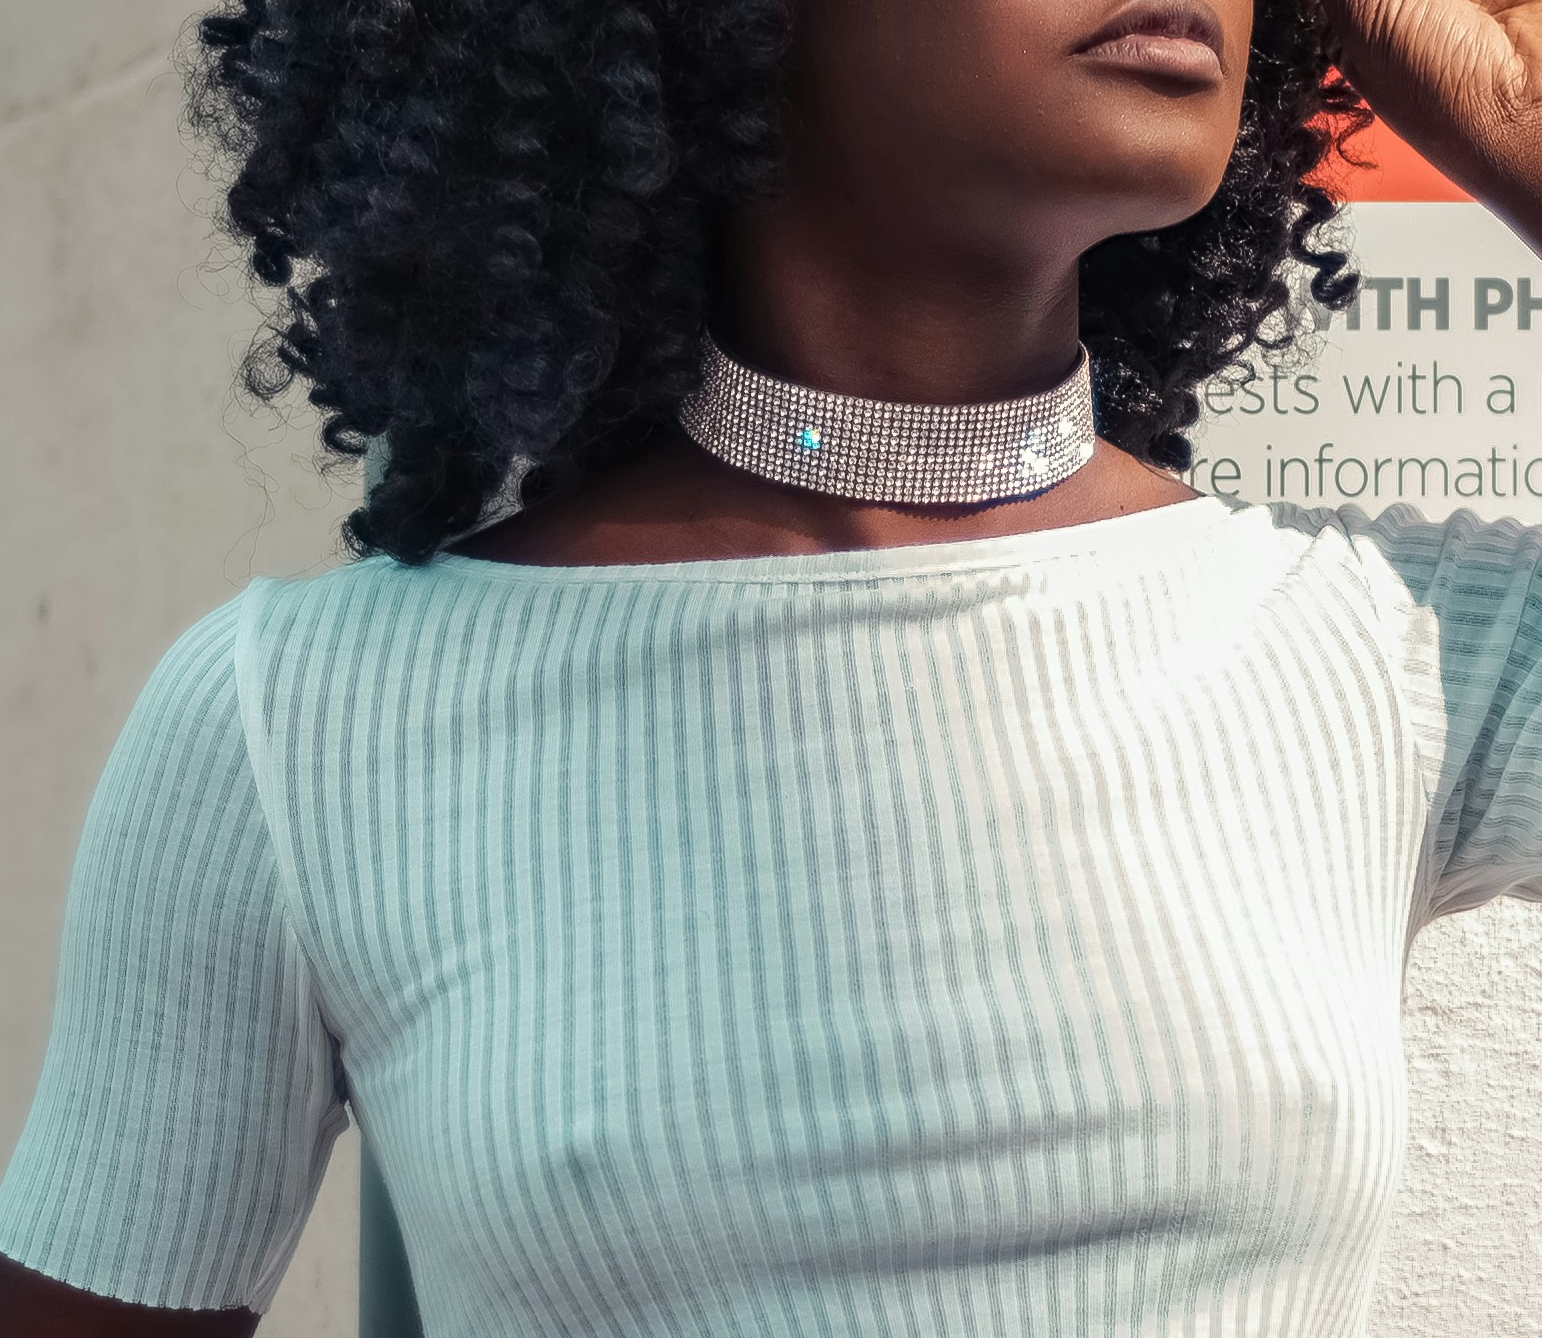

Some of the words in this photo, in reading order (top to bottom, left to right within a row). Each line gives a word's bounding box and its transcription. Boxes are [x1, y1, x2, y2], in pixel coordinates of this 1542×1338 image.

[1315, 276, 1450, 331] ITH
[1203, 363, 1320, 415] ests
[1342, 359, 1464, 415] with
[1486, 372, 1516, 415] a
[1190, 455, 1243, 498] re
